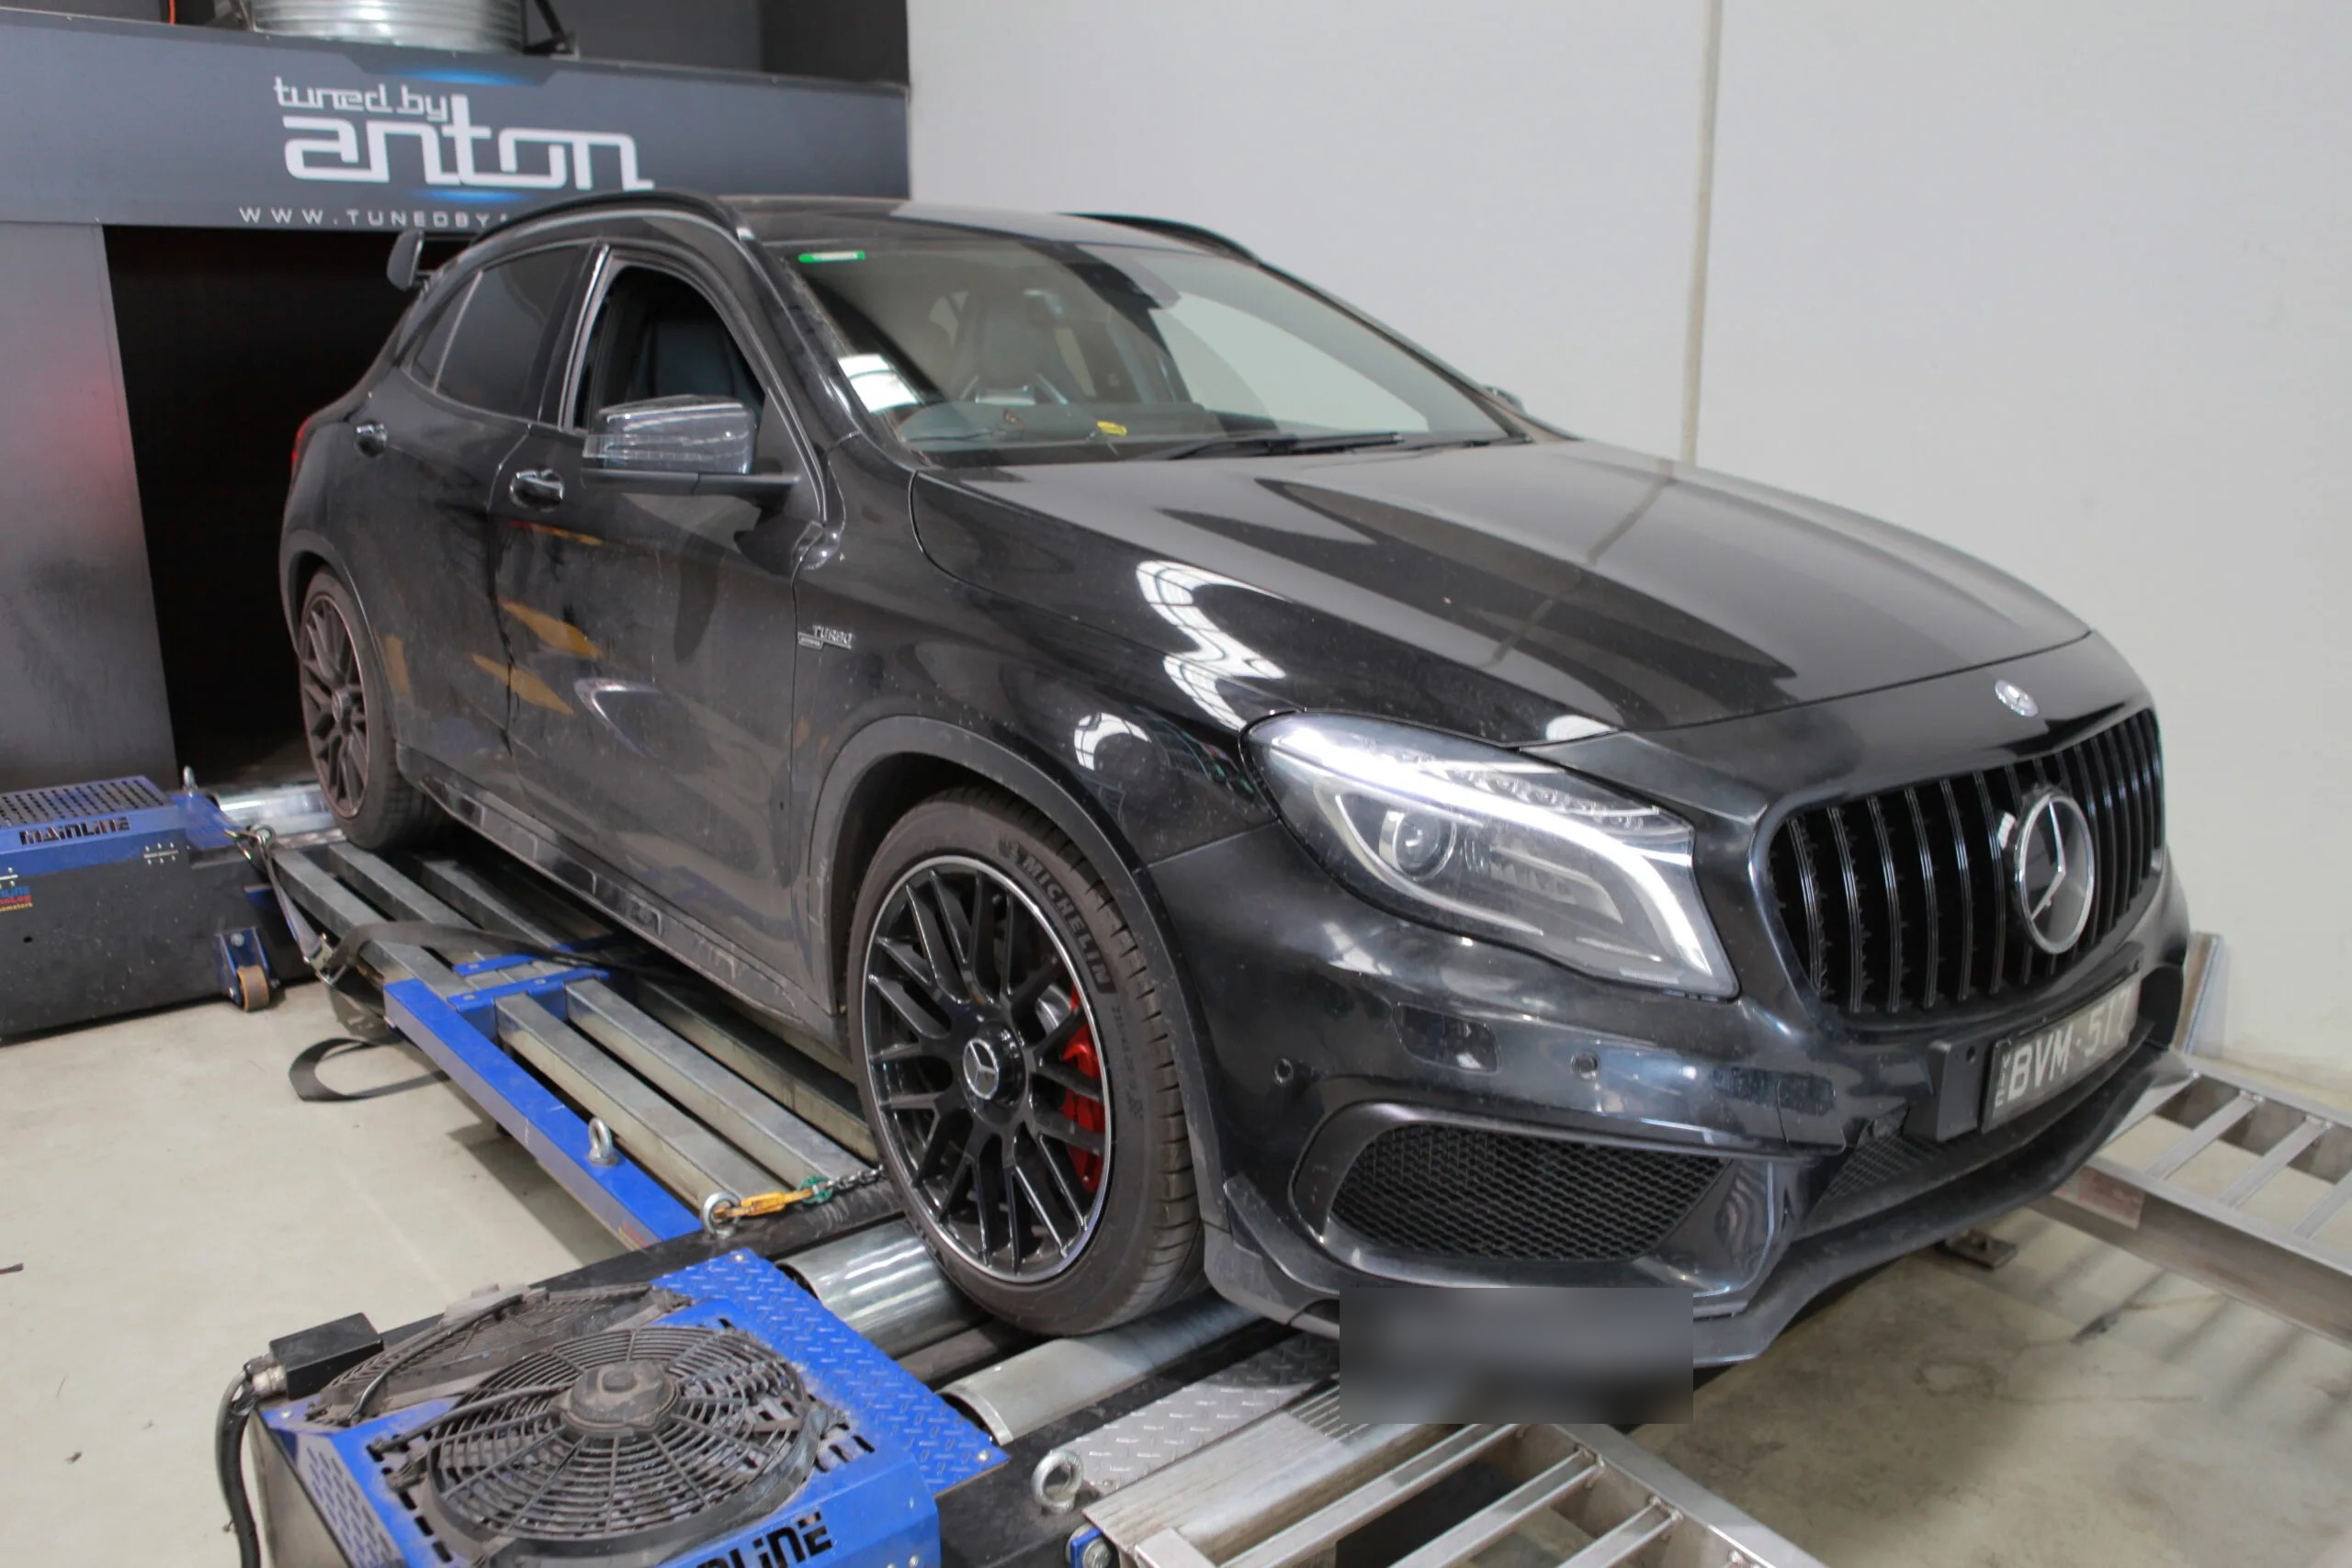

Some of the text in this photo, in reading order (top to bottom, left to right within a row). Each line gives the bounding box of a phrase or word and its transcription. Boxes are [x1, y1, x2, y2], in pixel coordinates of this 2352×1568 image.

[274, 76, 448, 122] tuned by
[282, 95, 655, 192] anton
[238, 206, 510, 229] WWW.TUNEDBY
[1022, 855, 1113, 989] MICHELIN
